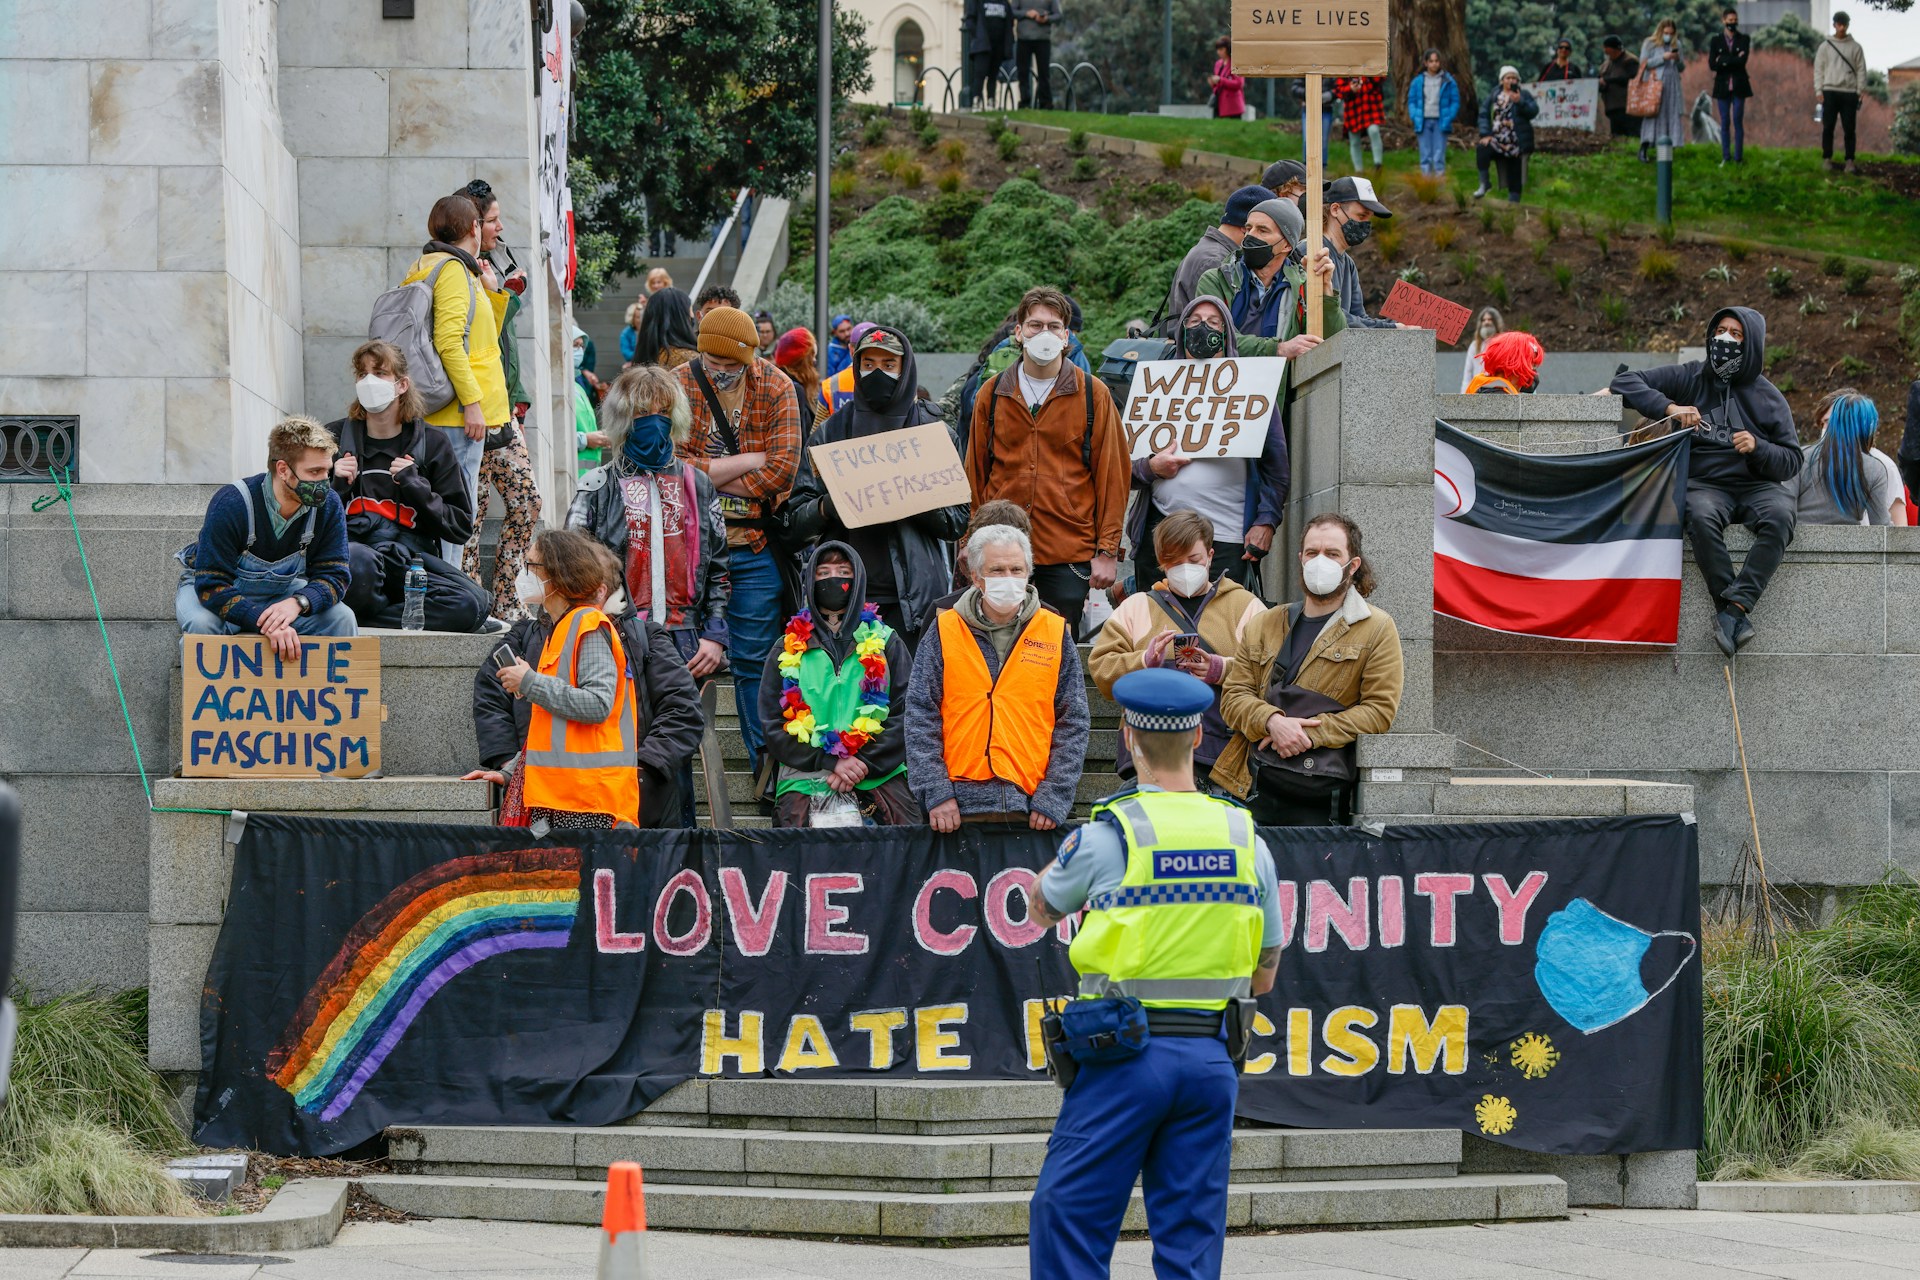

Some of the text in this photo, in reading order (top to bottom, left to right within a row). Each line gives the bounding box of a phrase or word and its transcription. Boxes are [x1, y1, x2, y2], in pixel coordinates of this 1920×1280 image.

[1252, 9, 1370, 26] SAVE LIVES
[1385, 301, 1400, 316] WE
[1399, 304, 1418, 322] SAY
[1394, 282, 1469, 326] YOU SAY APOSTLE
[1143, 359, 1239, 396] WHO
[1129, 394, 1270, 422] ELECTED
[886, 437, 922, 465] OFF
[1125, 421, 1240, 457] YOU?
[844, 463, 965, 513] VFF FASCISTS
[196, 642, 352, 684] UNITE
[191, 685, 369, 727] AGAINST
[190, 730, 370, 773] FASCHISM
[1160, 855, 1231, 872] POLICE
[594, 867, 870, 957] LOVE
[699, 1002, 972, 1075] HATE
